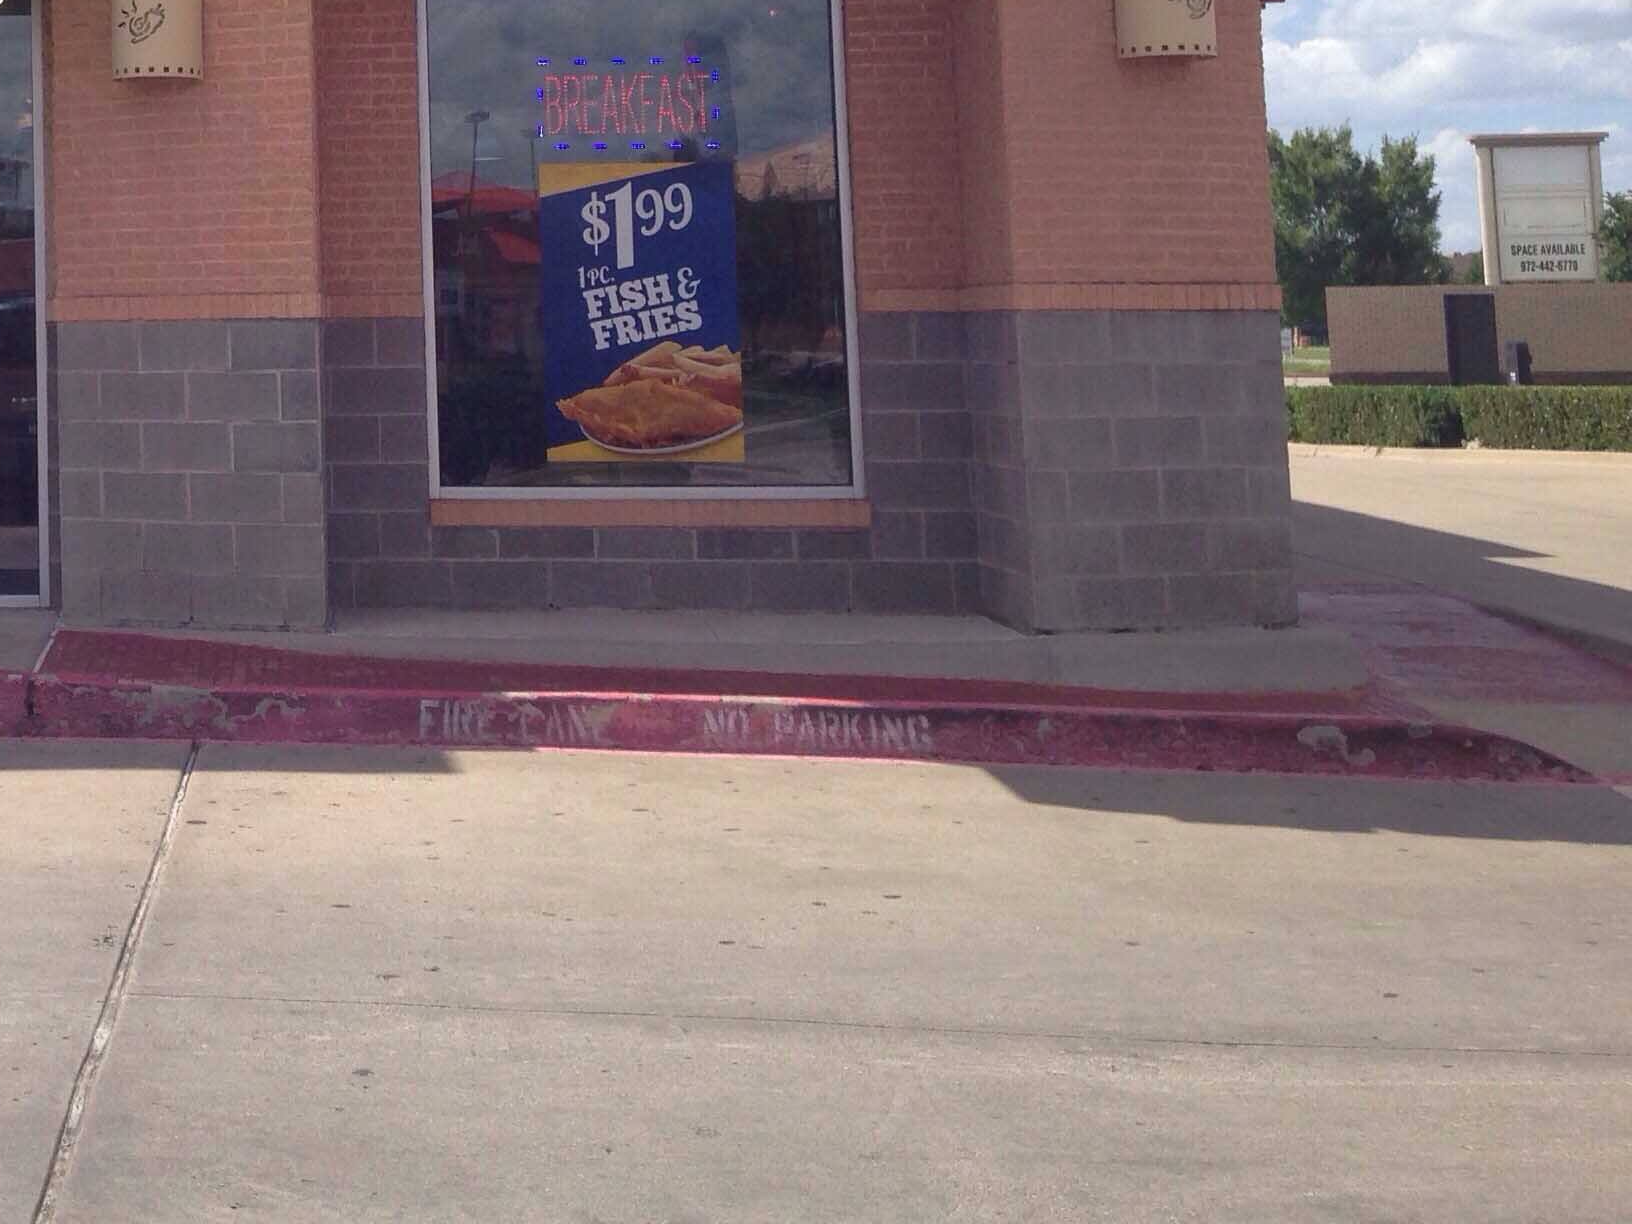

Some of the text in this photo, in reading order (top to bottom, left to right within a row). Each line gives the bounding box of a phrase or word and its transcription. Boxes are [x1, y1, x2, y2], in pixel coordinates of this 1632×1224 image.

[543, 72, 710, 136] BREAKFAST
[1510, 244, 1538, 257] SPACE
[582, 266, 701, 320] FISH &
[590, 299, 703, 351] FRIES
[774, 710, 935, 753] PARKING
